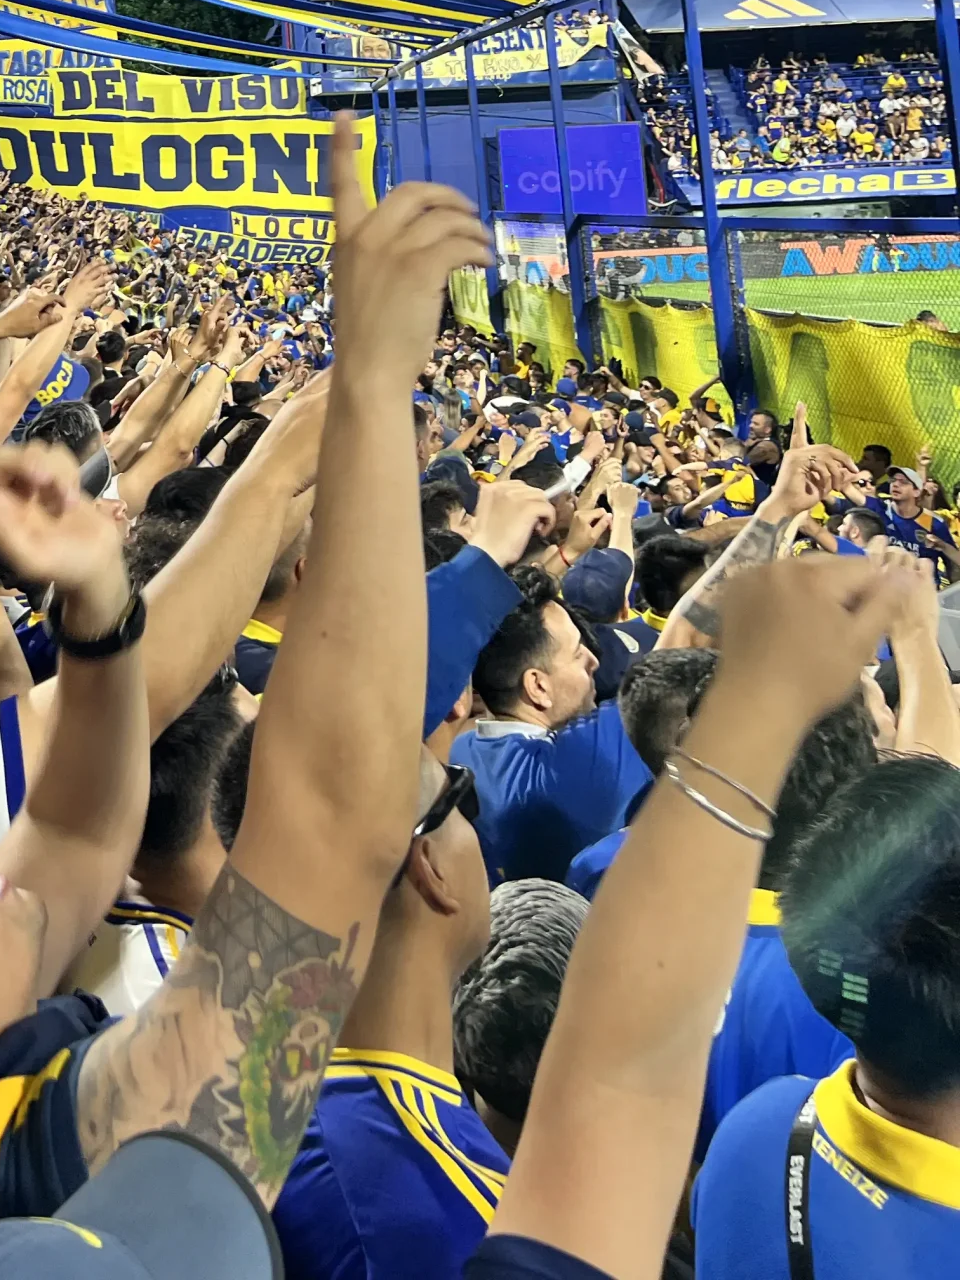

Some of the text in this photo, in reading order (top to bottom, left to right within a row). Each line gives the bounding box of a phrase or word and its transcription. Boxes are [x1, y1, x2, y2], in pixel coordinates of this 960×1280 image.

[3, 77, 49, 103] ROSA
[57, 70, 155, 113] DEL
[715, 173, 889, 199] flecha
[35, 360, 74, 407] BOCA
[789, 1155, 805, 1245] EVERLAST
